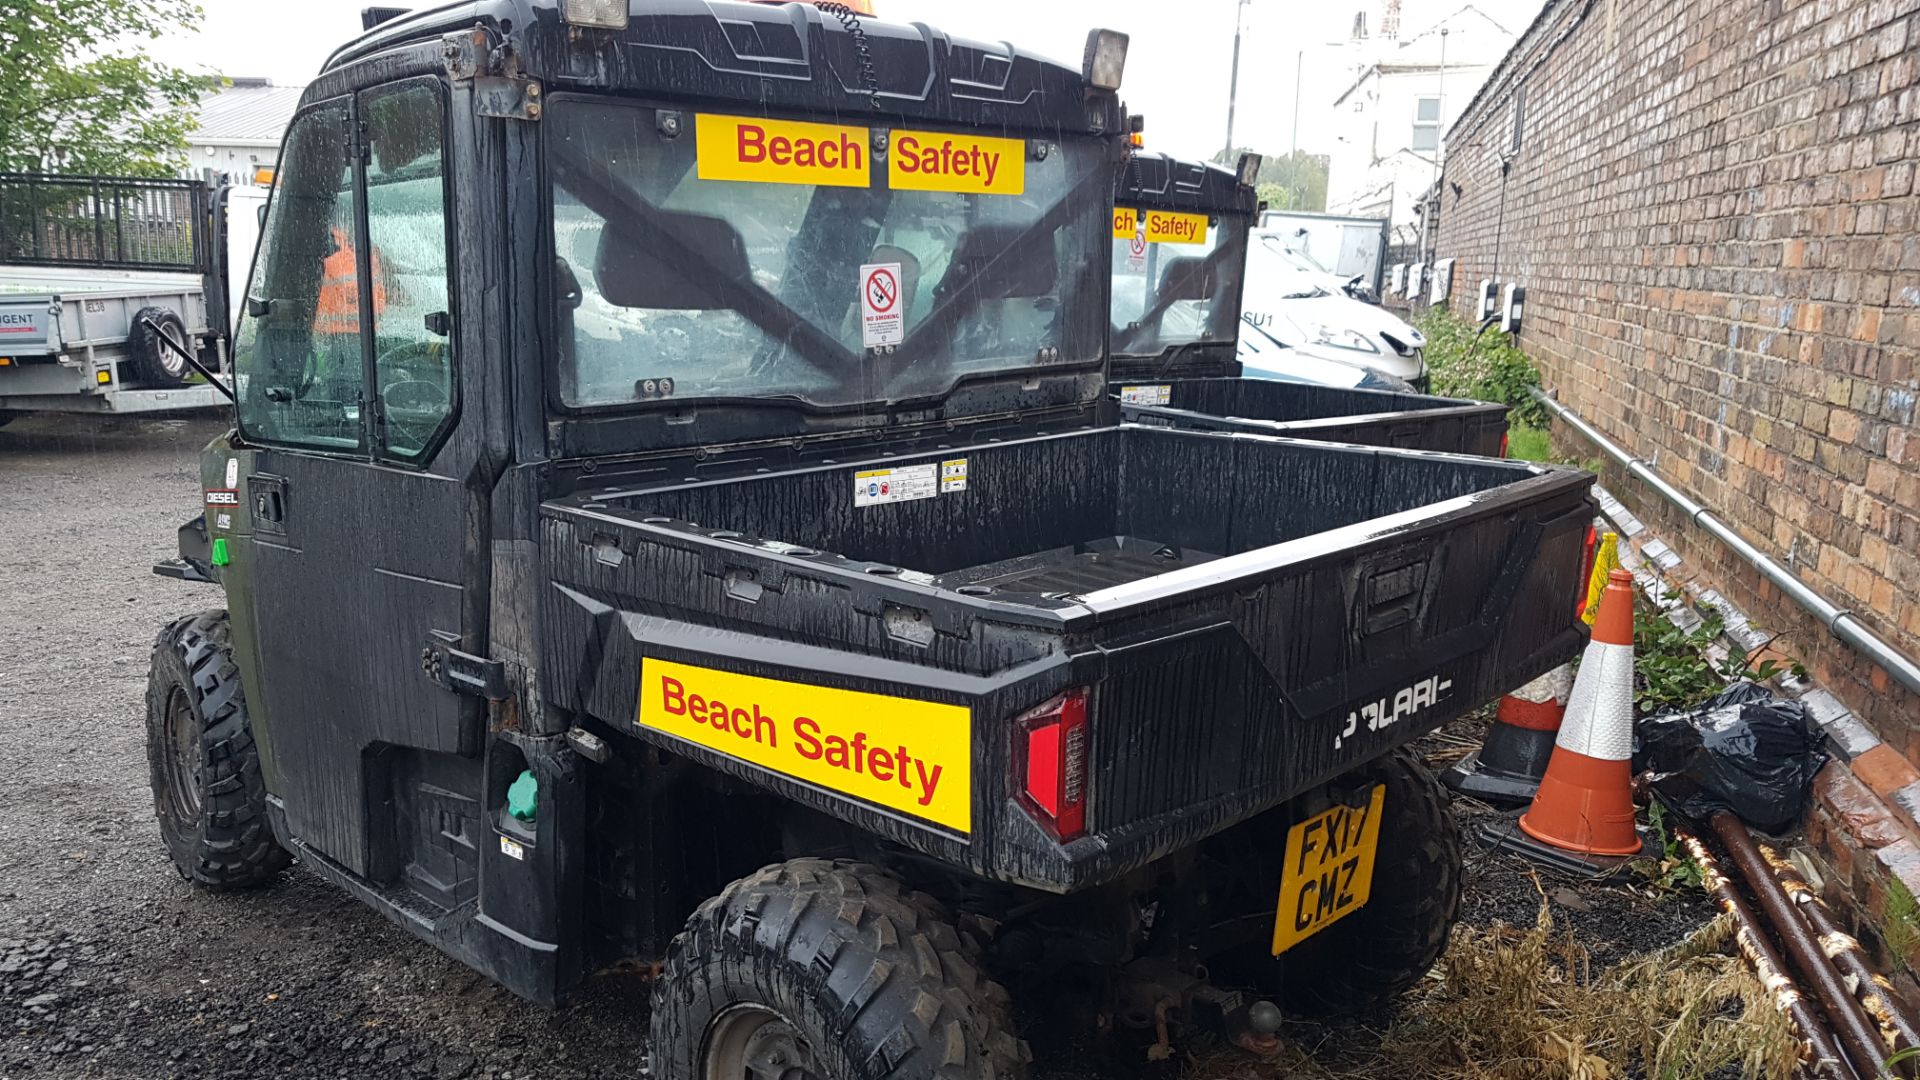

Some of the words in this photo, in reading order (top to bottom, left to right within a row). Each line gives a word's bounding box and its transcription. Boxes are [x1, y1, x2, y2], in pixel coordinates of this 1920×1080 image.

[737, 124, 862, 170] Beach
[897, 136, 1000, 187] Safety
[1113, 212, 1133, 231] ch
[1151, 215, 1198, 241] Safety
[875, 313, 900, 321] SMOKING
[1243, 311, 1273, 327] SU1
[661, 675, 777, 748] Beach
[793, 716, 943, 806] Safety
[1295, 855, 1360, 933] CMZ
